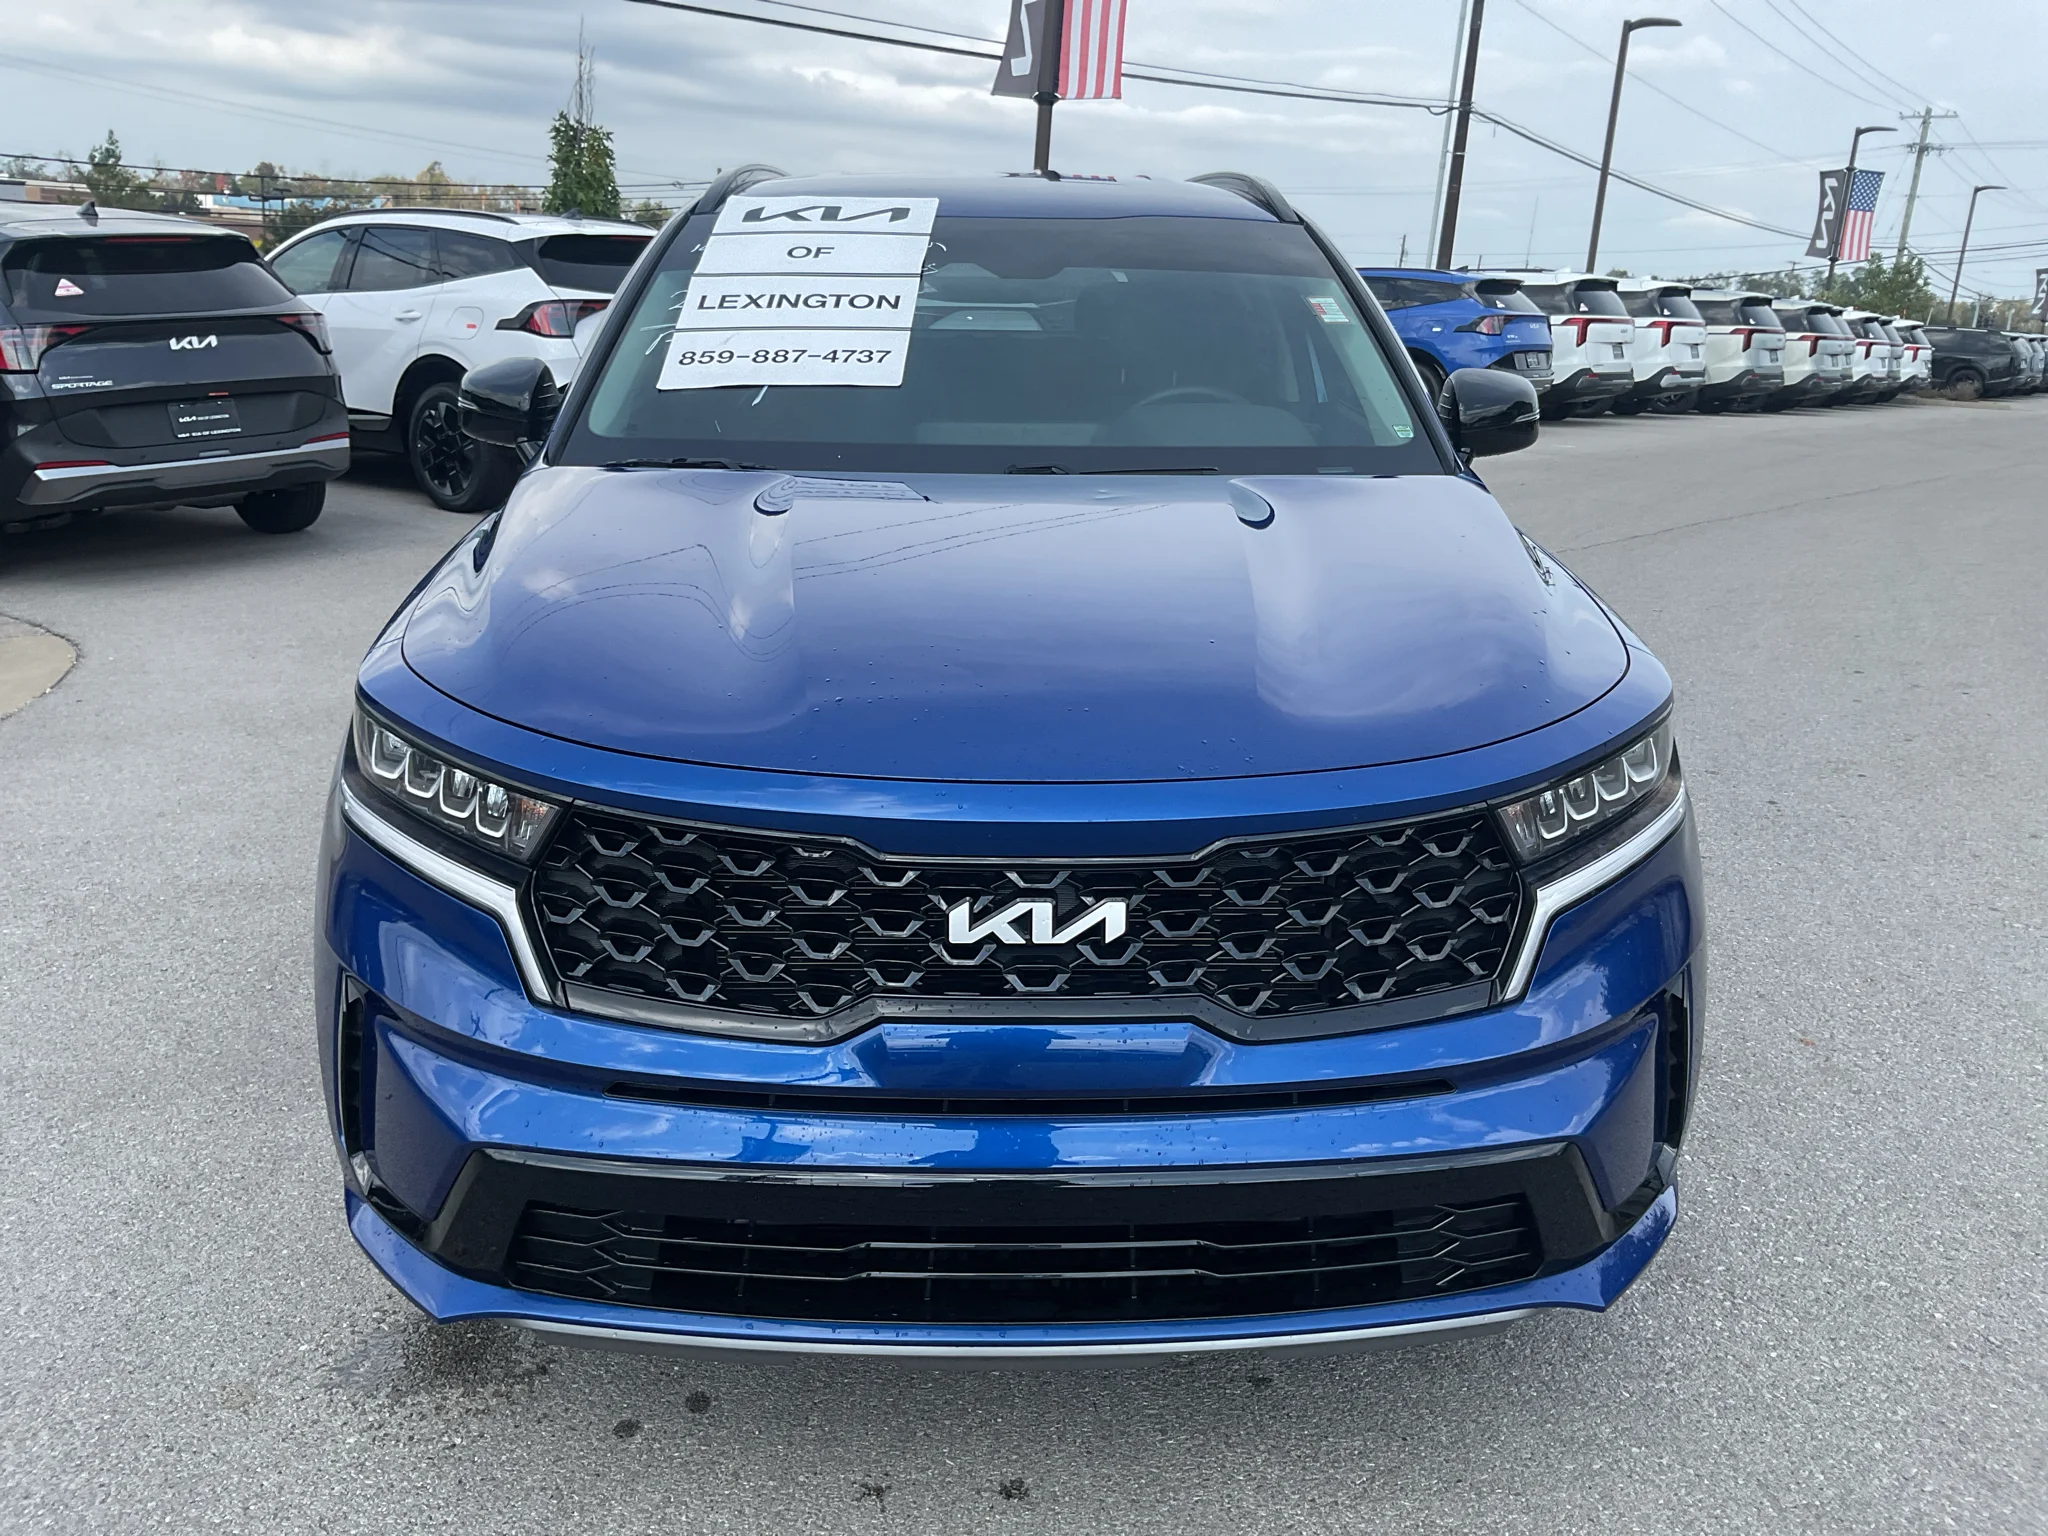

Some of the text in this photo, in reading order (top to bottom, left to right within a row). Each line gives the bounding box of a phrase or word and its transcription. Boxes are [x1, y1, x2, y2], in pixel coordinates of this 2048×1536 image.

[741, 205, 912, 224] KIA
[786, 246, 835, 260] OF
[697, 293, 901, 311] LEXINGTON
[169, 334, 218, 351] KIA
[678, 348, 892, 366] 859-887-4737
[51, 380, 114, 390] SPORTAGE
[947, 898, 1128, 945] KIA
